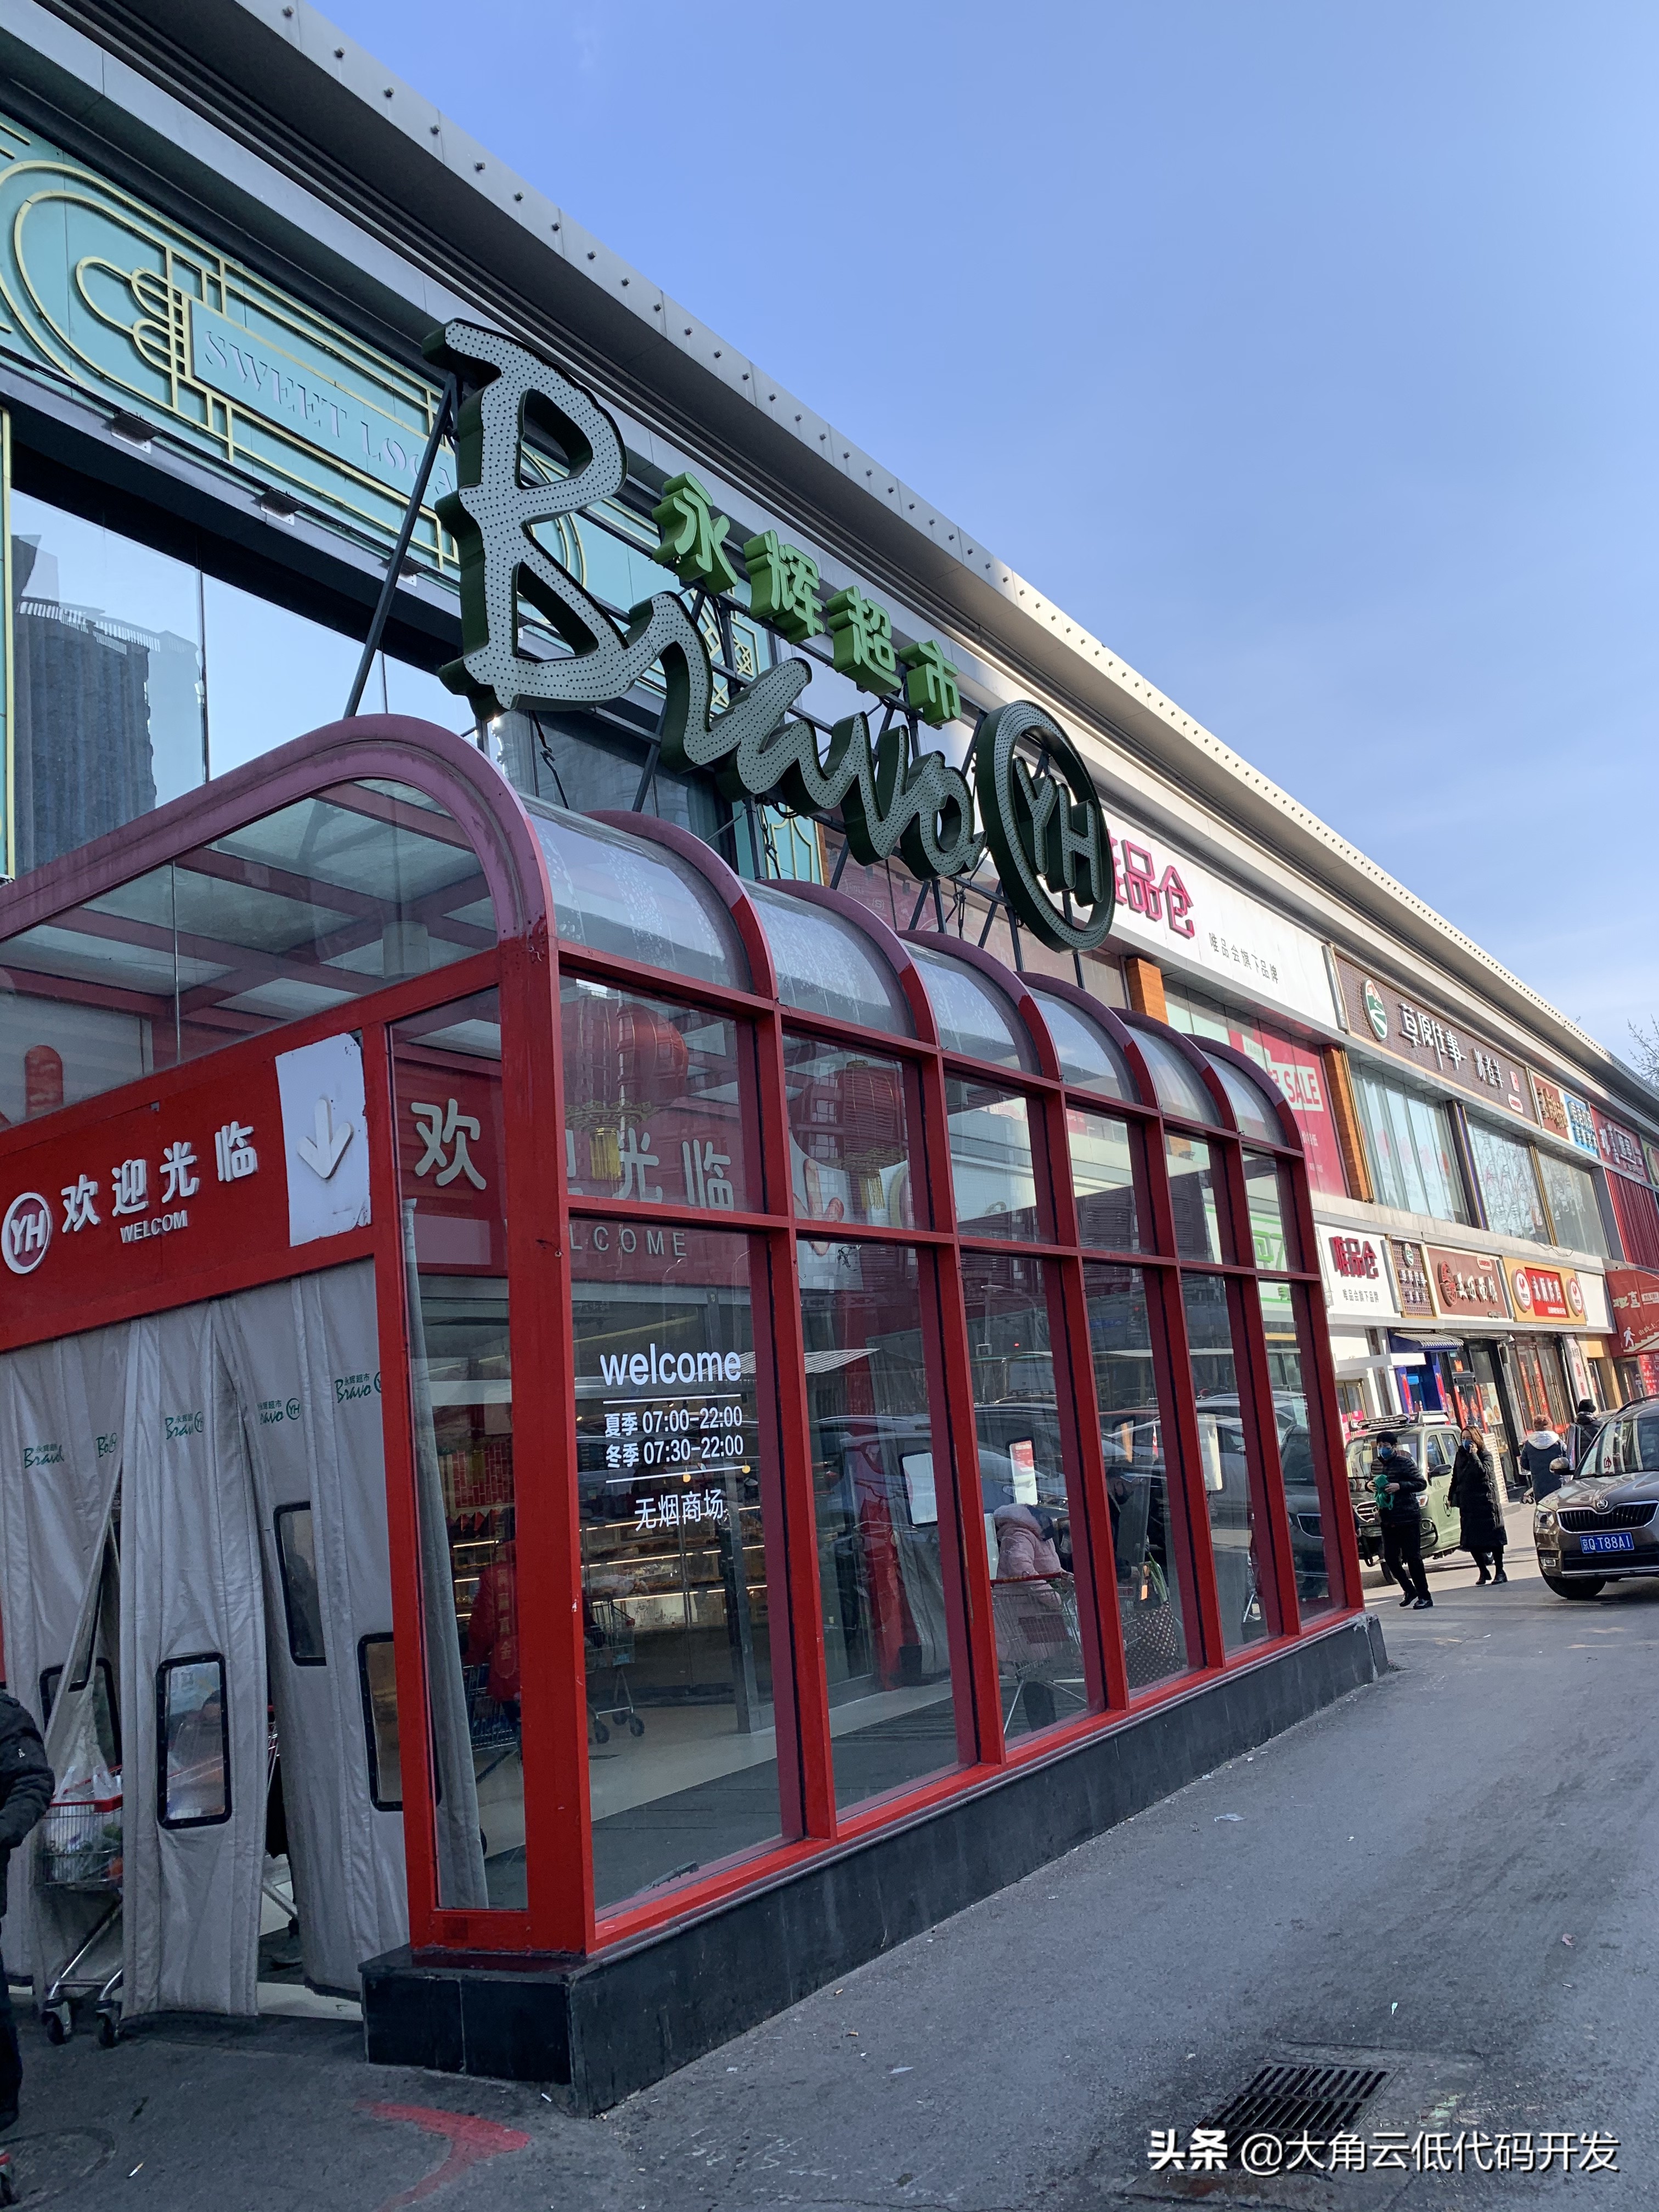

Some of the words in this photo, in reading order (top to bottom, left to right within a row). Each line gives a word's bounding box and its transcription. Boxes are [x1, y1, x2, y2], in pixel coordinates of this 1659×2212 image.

[205, 330, 348, 438] SWEET
[433, 318, 989, 881] Bravo
[656, 472, 961, 727] 永辉超市
[1208, 932, 1279, 984] 唯品会旗下品牌
[1398, 1002, 1468, 1070] 草原往事
[1284, 1070, 1321, 1105] SALE
[60, 1120, 258, 1234] 欢迎光临
[120, 1209, 189, 1244] WELCOM
[1329, 1235, 1379, 1279] 唯品仓
[1342, 1289, 1379, 1303] 唯品会旗下品牌
[600, 1343, 742, 1386] welcome
[334, 1379, 372, 1404] Bravo
[604, 1411, 638, 1438] 夏季
[642, 1405, 743, 1434] 07:00-22:00
[605, 1442, 639, 1469] 冬季
[644, 1434, 744, 1464] 07:30-22:00
[634, 1488, 725, 1532] 无烟商场
